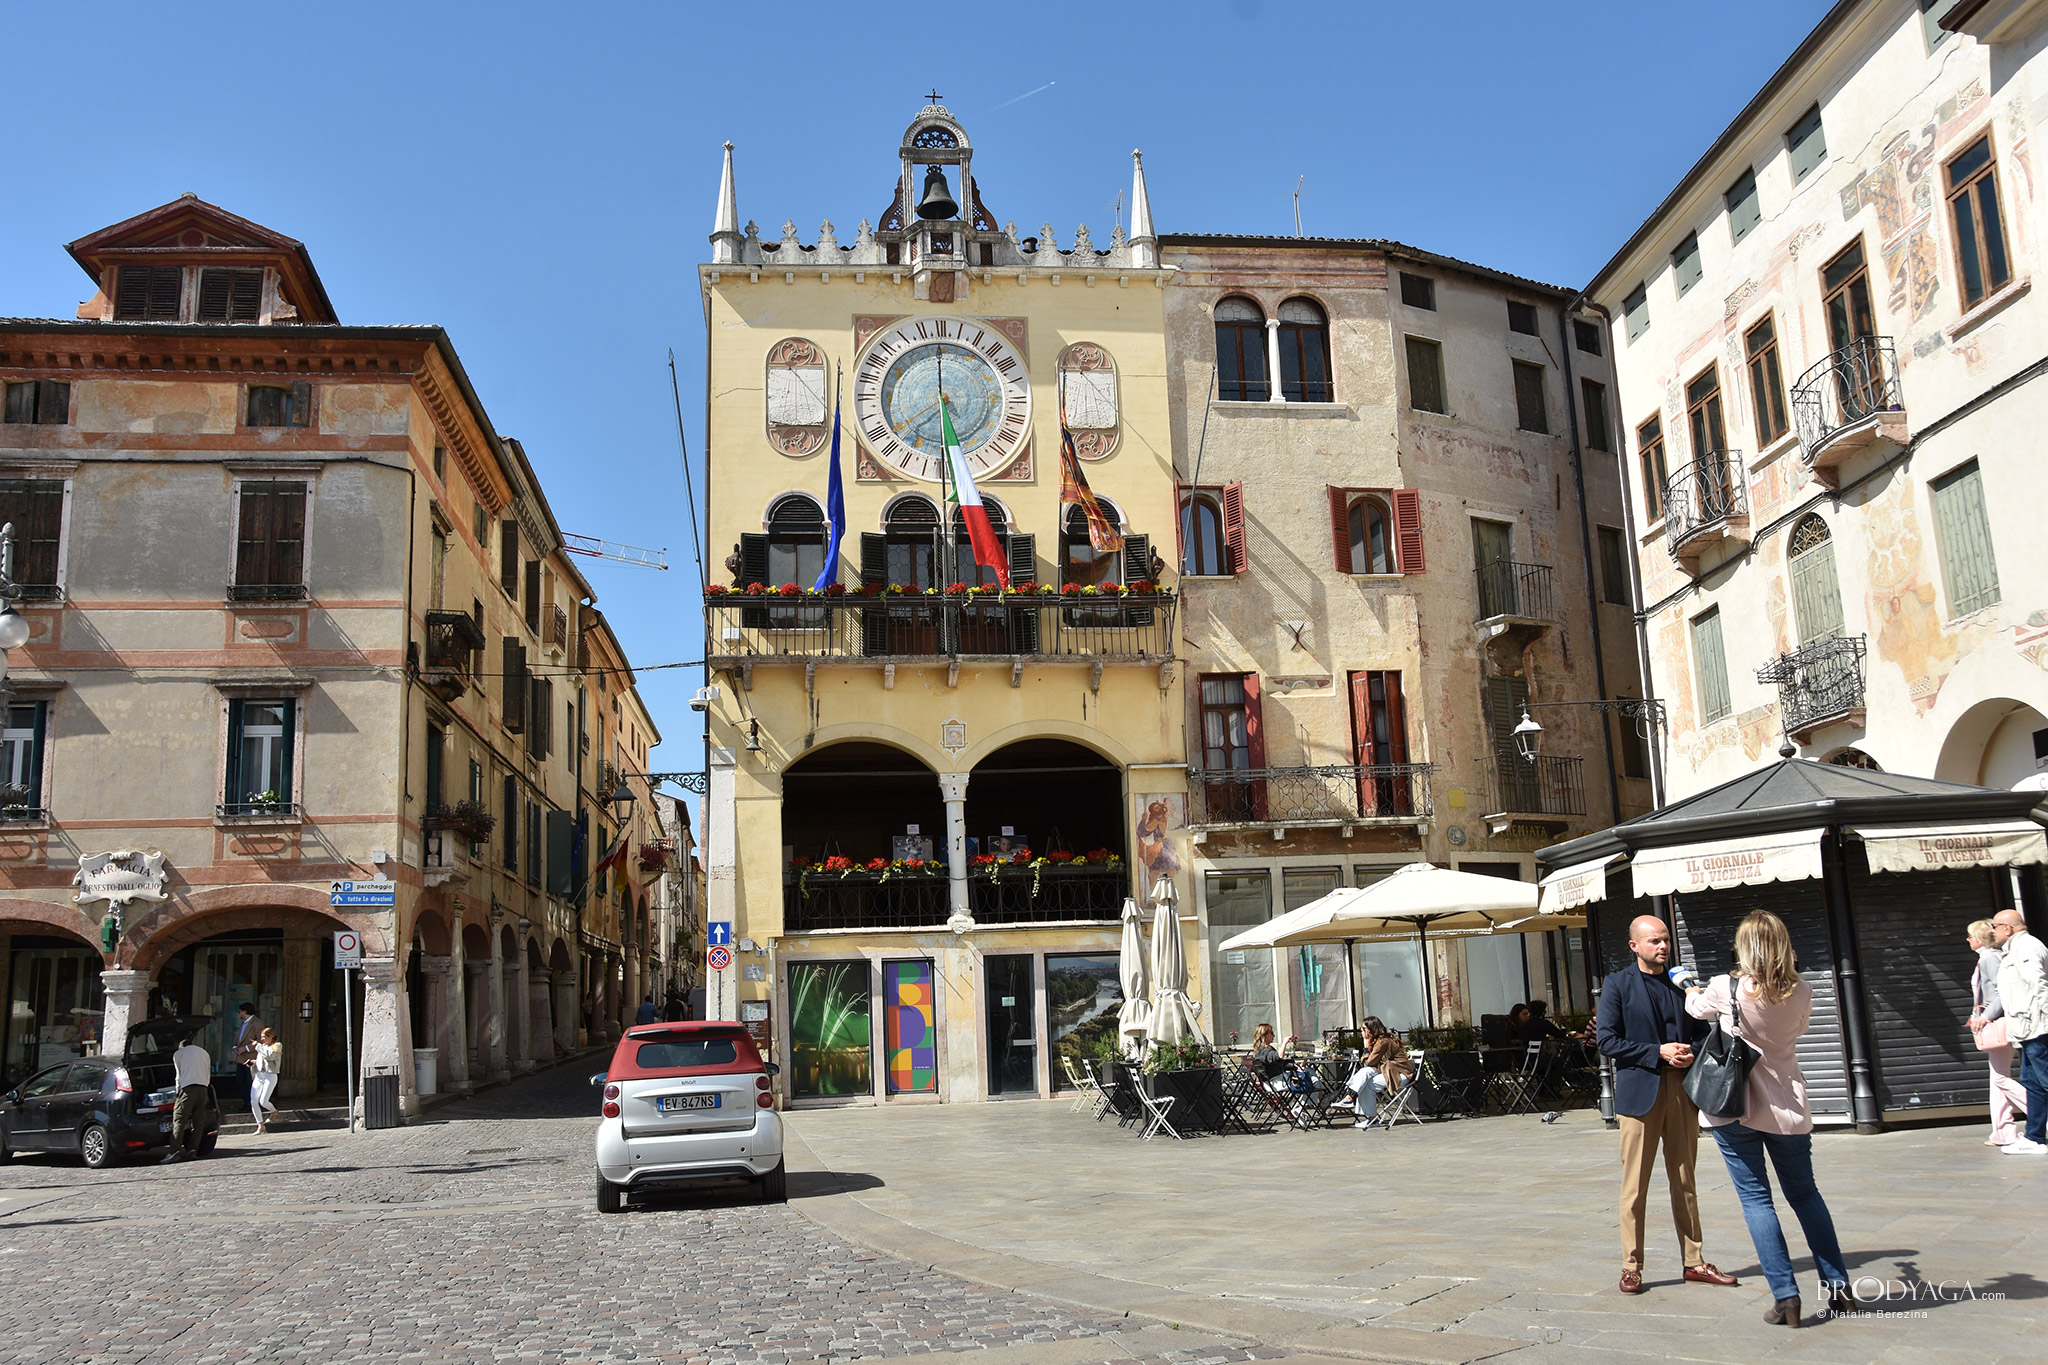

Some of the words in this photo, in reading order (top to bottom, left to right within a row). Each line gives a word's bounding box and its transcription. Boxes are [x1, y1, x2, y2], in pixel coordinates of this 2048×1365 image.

[1918, 840, 1931, 851] IL
[1935, 836, 1993, 850] GIORNALE
[1686, 860, 1700, 872] IL
[1703, 852, 1764, 870] GIORNALE
[1924, 851, 1938, 863] DI
[1941, 848, 1993, 862] VICENZA
[91, 862, 151, 878] FARMACIA
[1691, 872, 1704, 884] DI
[1709, 865, 1761, 882] VICENZA
[1563, 875, 1584, 892] GIORNALE
[665, 1098, 678, 1109] EV
[681, 1096, 714, 1108] 847NS
